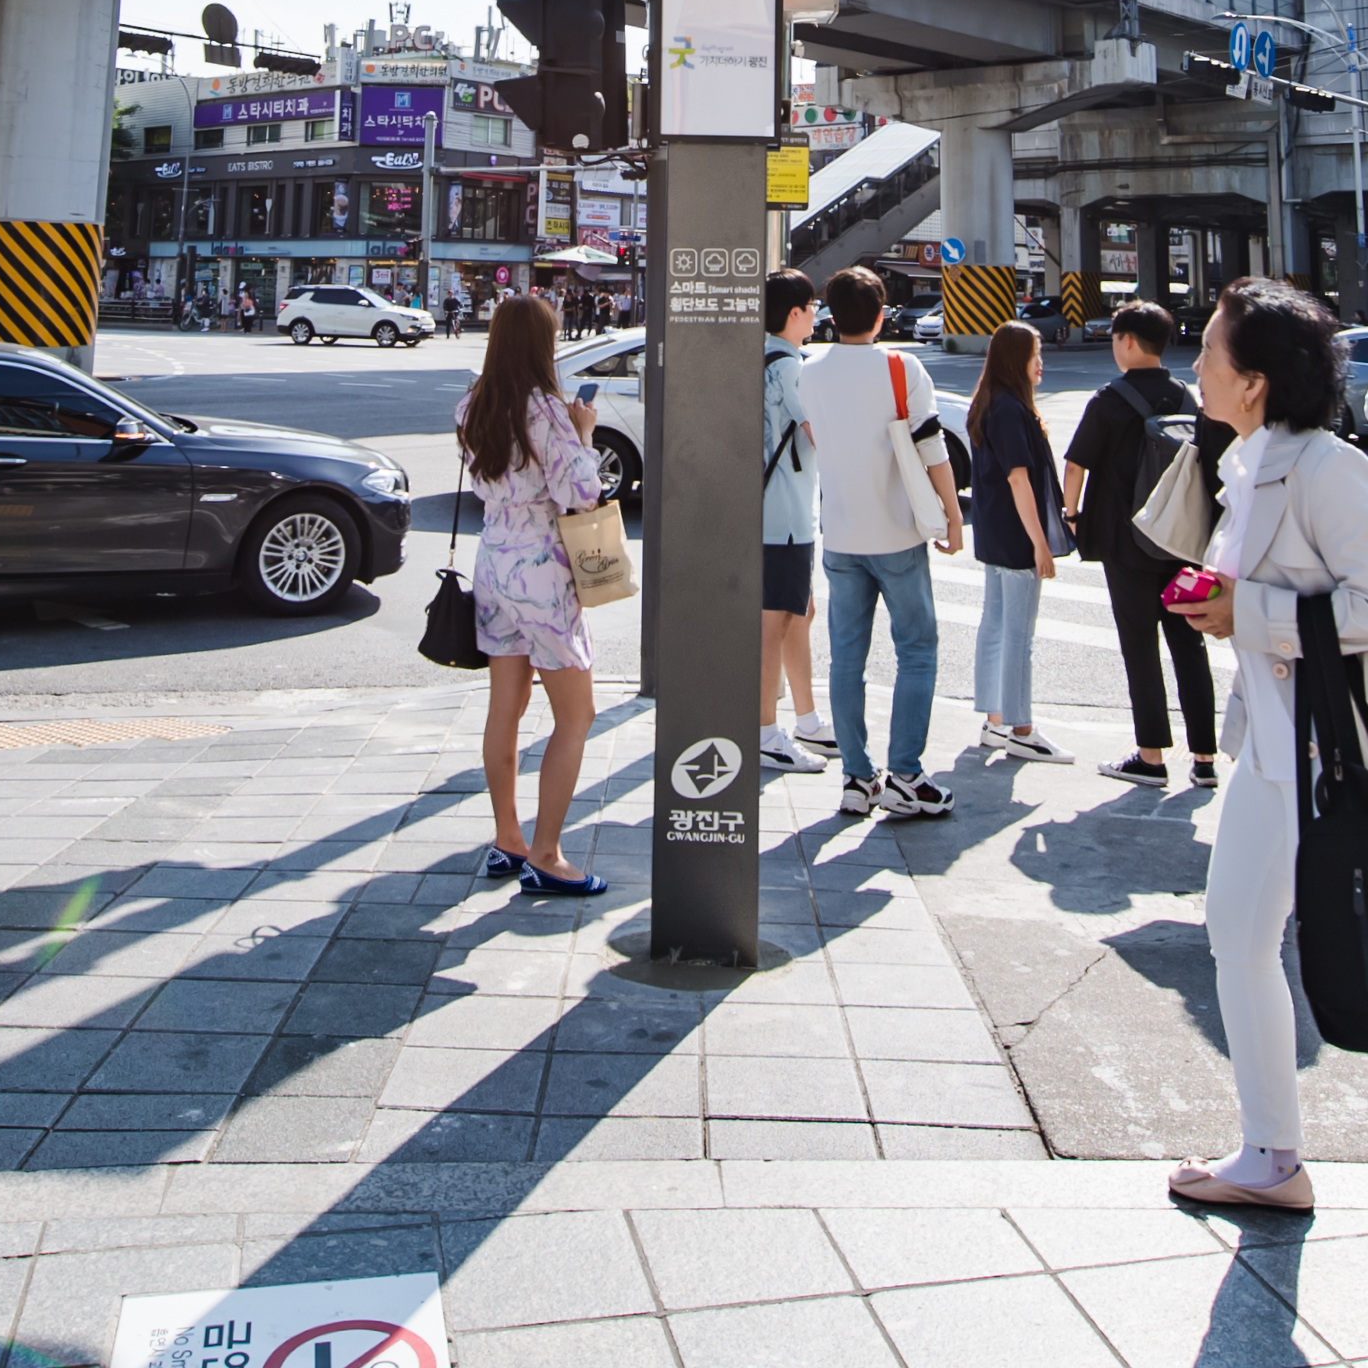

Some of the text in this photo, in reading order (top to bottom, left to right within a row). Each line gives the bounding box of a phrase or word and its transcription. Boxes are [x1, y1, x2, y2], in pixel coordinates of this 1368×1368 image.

[389, 24, 432, 51] PC
[699, 55, 768, 68] 가치더하기 광진
[236, 96, 310, 121] 스타시티치과
[340, 107, 352, 137] 치과
[227, 160, 274, 173] EATS BISTRO
[669, 280, 708, 295] 스마트
[669, 297, 761, 313] 횡단보도 그늘막
[669, 316, 761, 324] PEDESTRIAN SAFE AREA
[668, 809, 745, 832] 광진구
[666, 830, 746, 844] GWANGJIN-GU
[176, 1325, 196, 1347] No
